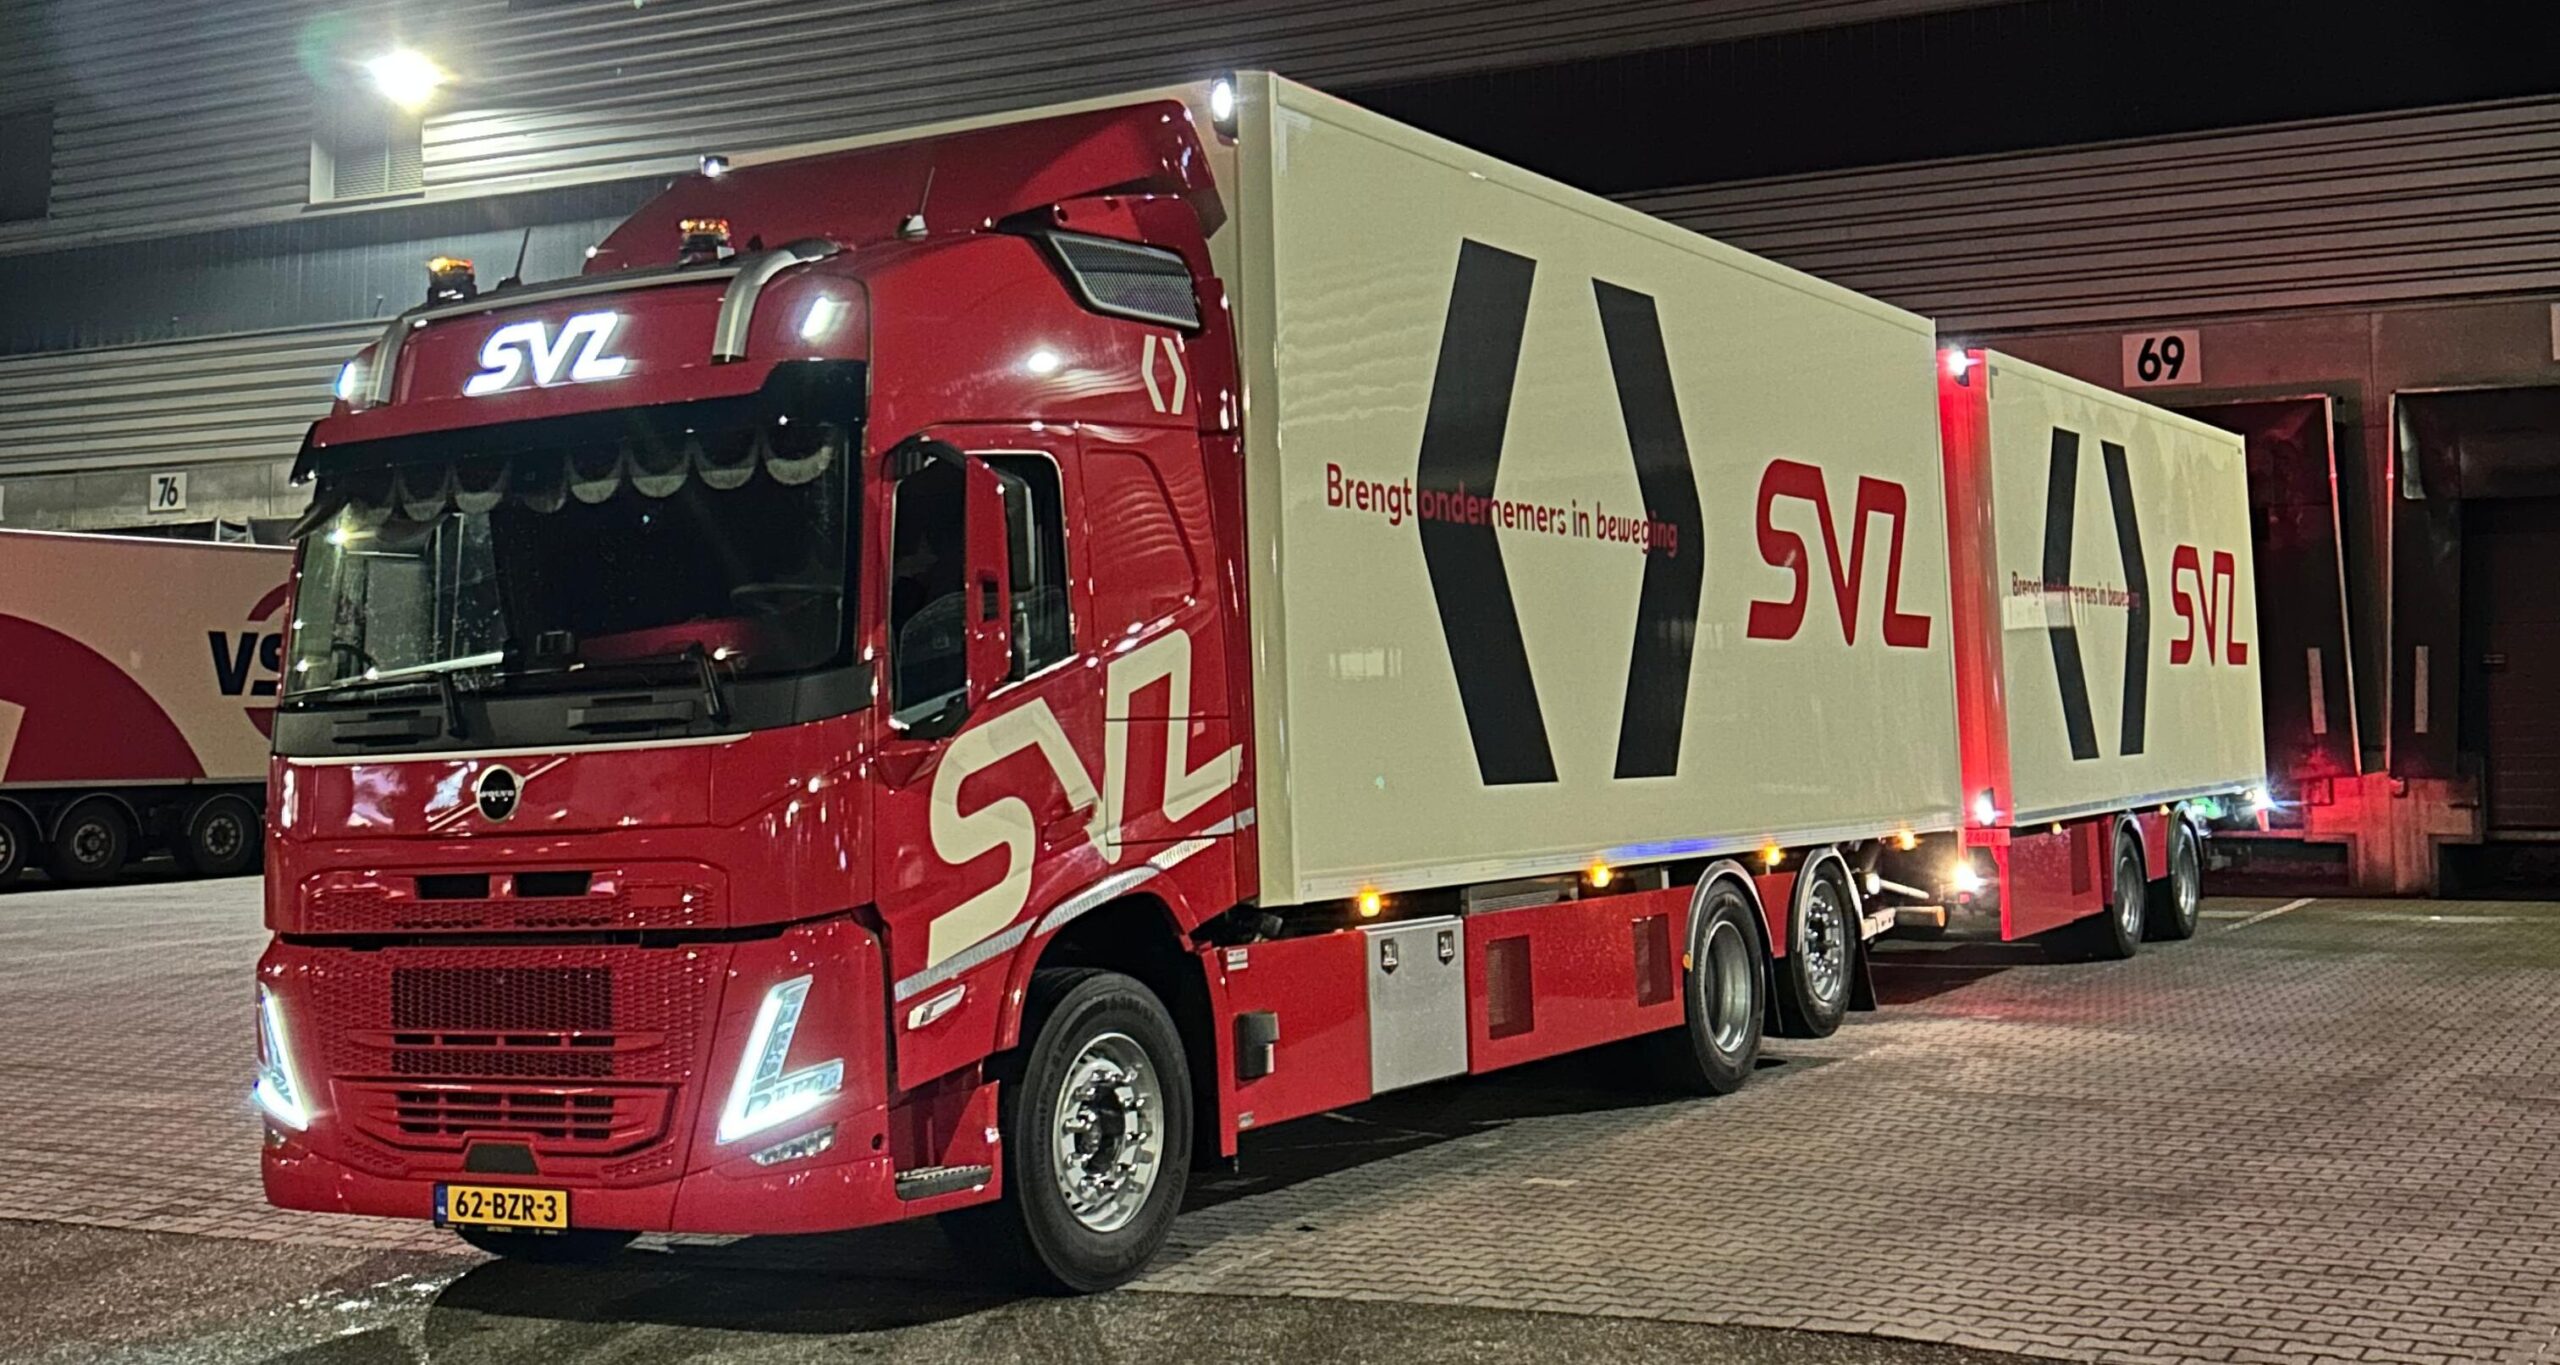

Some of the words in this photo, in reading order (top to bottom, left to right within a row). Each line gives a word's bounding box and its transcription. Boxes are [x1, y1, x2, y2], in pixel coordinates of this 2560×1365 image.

[2138, 336, 2185, 382] 69
[158, 477, 178, 507] 76
[1326, 463, 1412, 526] Brengt
[1420, 481, 1566, 536] ondernemers
[1572, 499, 1590, 538] in
[1596, 502, 1678, 558] beweging
[455, 1190, 557, 1223] 62-BZR-3
